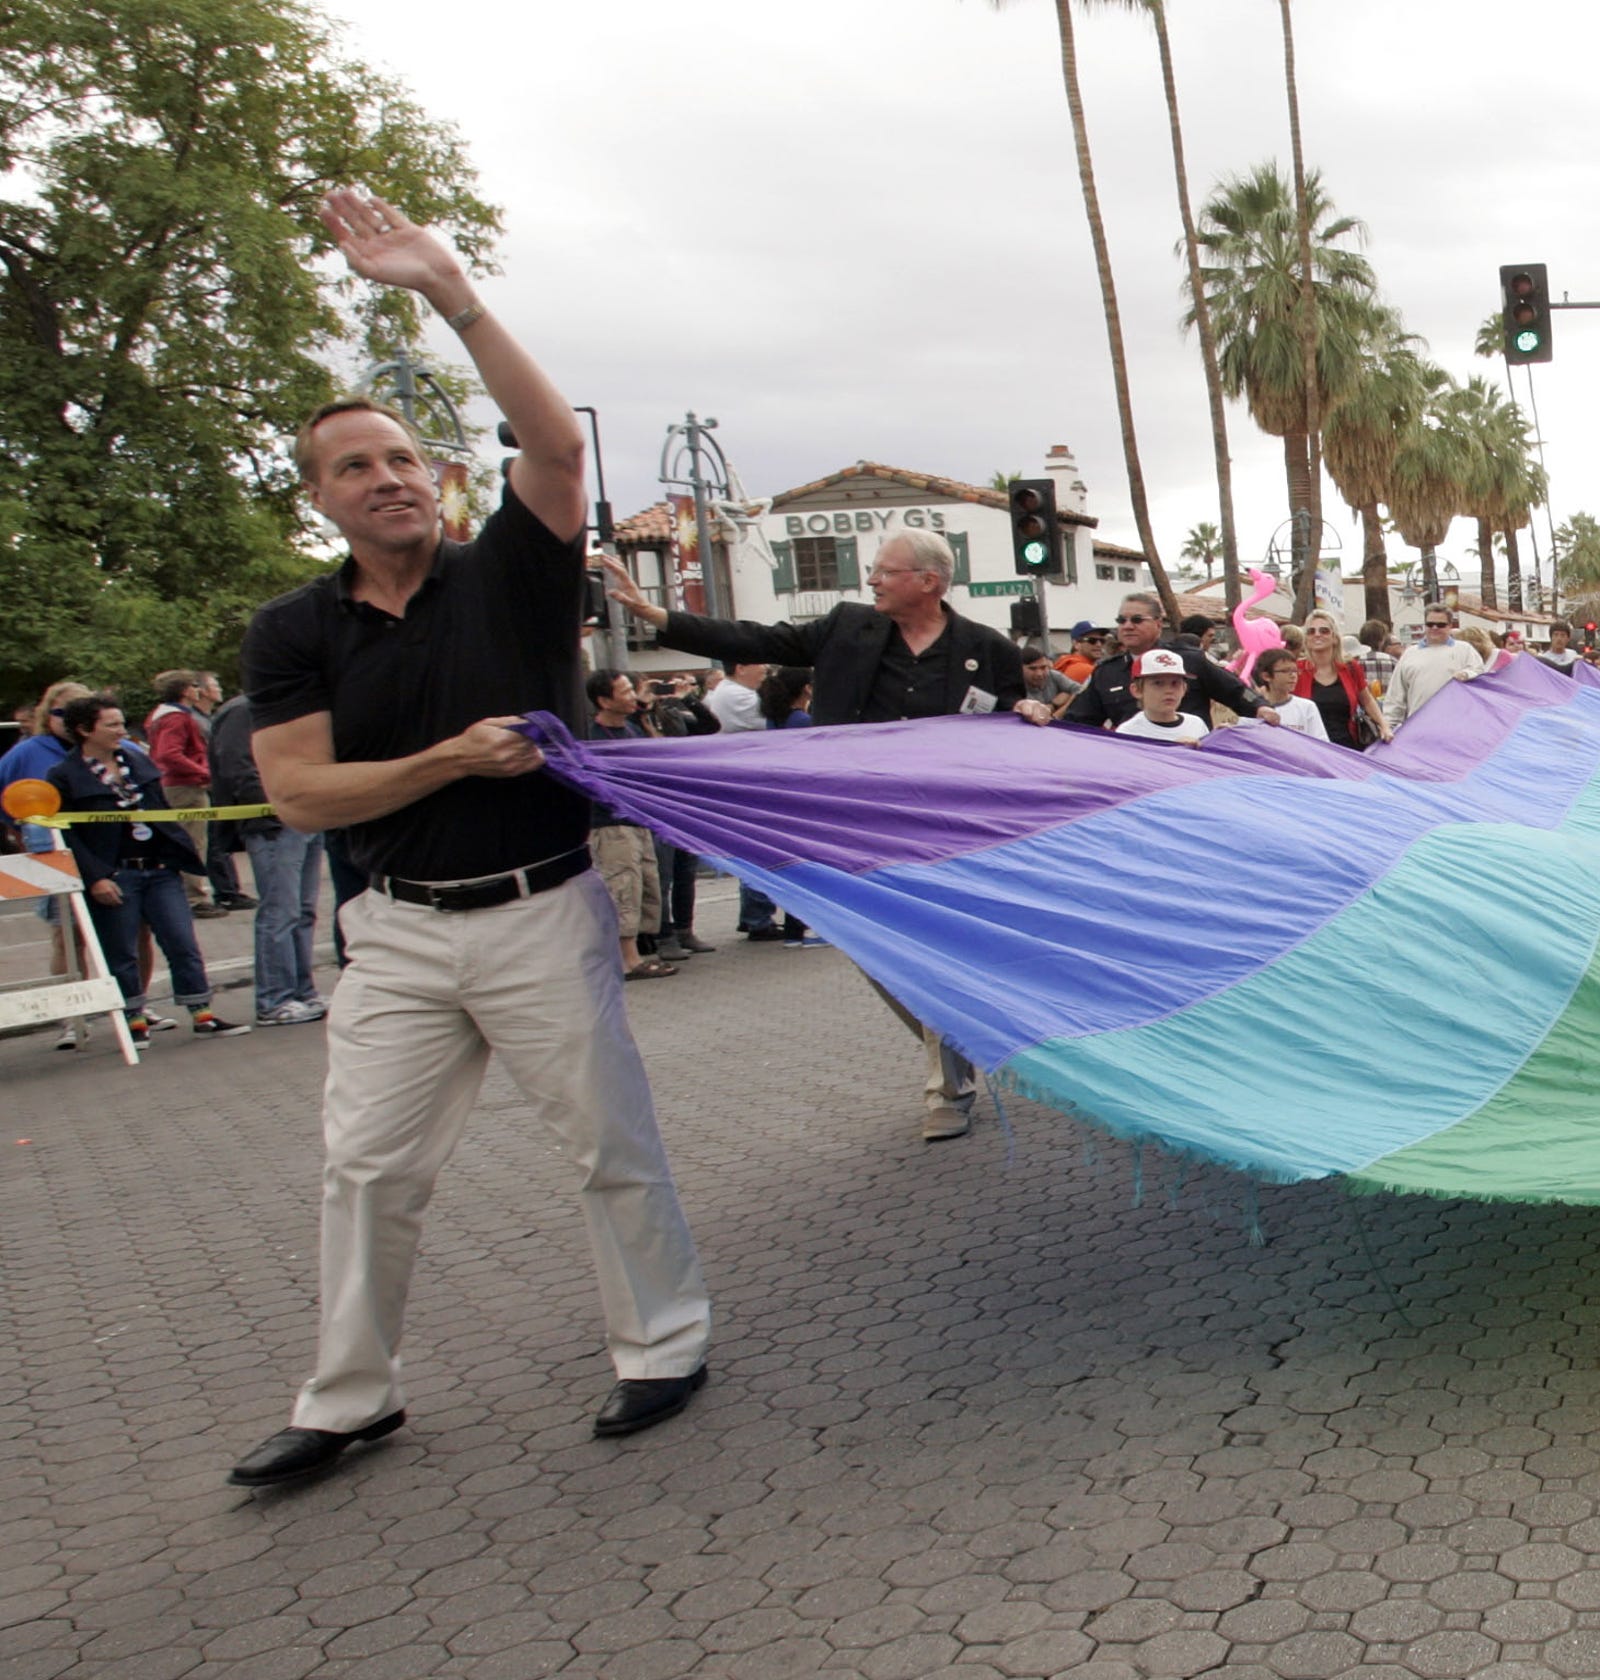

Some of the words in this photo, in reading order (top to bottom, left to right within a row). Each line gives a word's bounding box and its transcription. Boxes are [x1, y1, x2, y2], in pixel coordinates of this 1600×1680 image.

[785, 510, 895, 537] BOBBY
[972, 585, 988, 596] LA
[995, 583, 1031, 595] PLAZA
